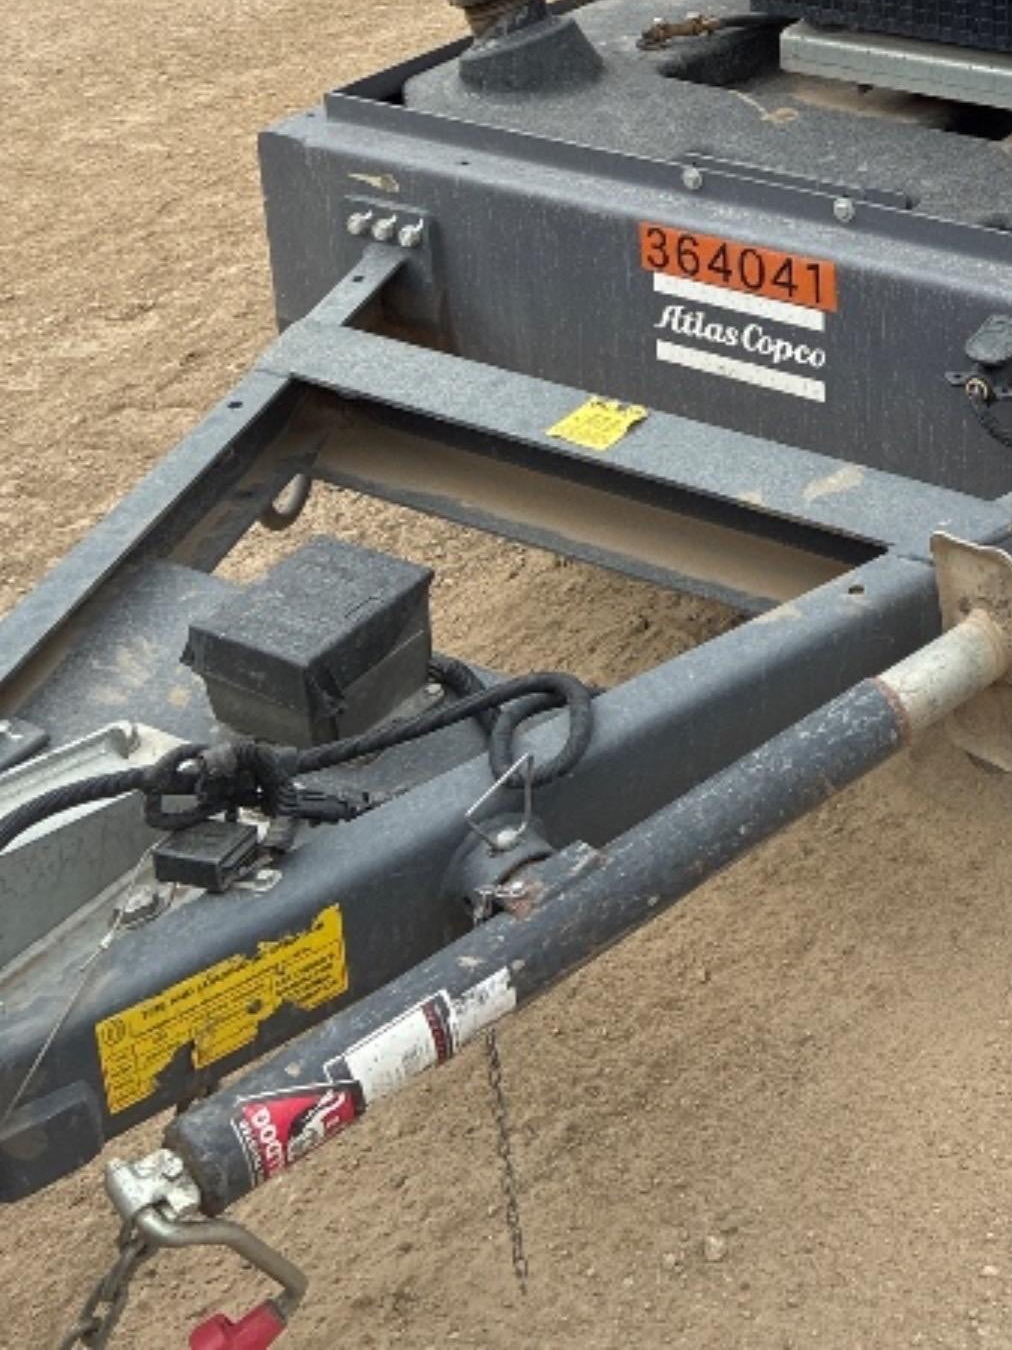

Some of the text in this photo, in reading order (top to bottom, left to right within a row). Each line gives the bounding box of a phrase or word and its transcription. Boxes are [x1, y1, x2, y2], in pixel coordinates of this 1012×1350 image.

[646, 226, 821, 304] 364041
[653, 304, 826, 368] Atlas Copco
